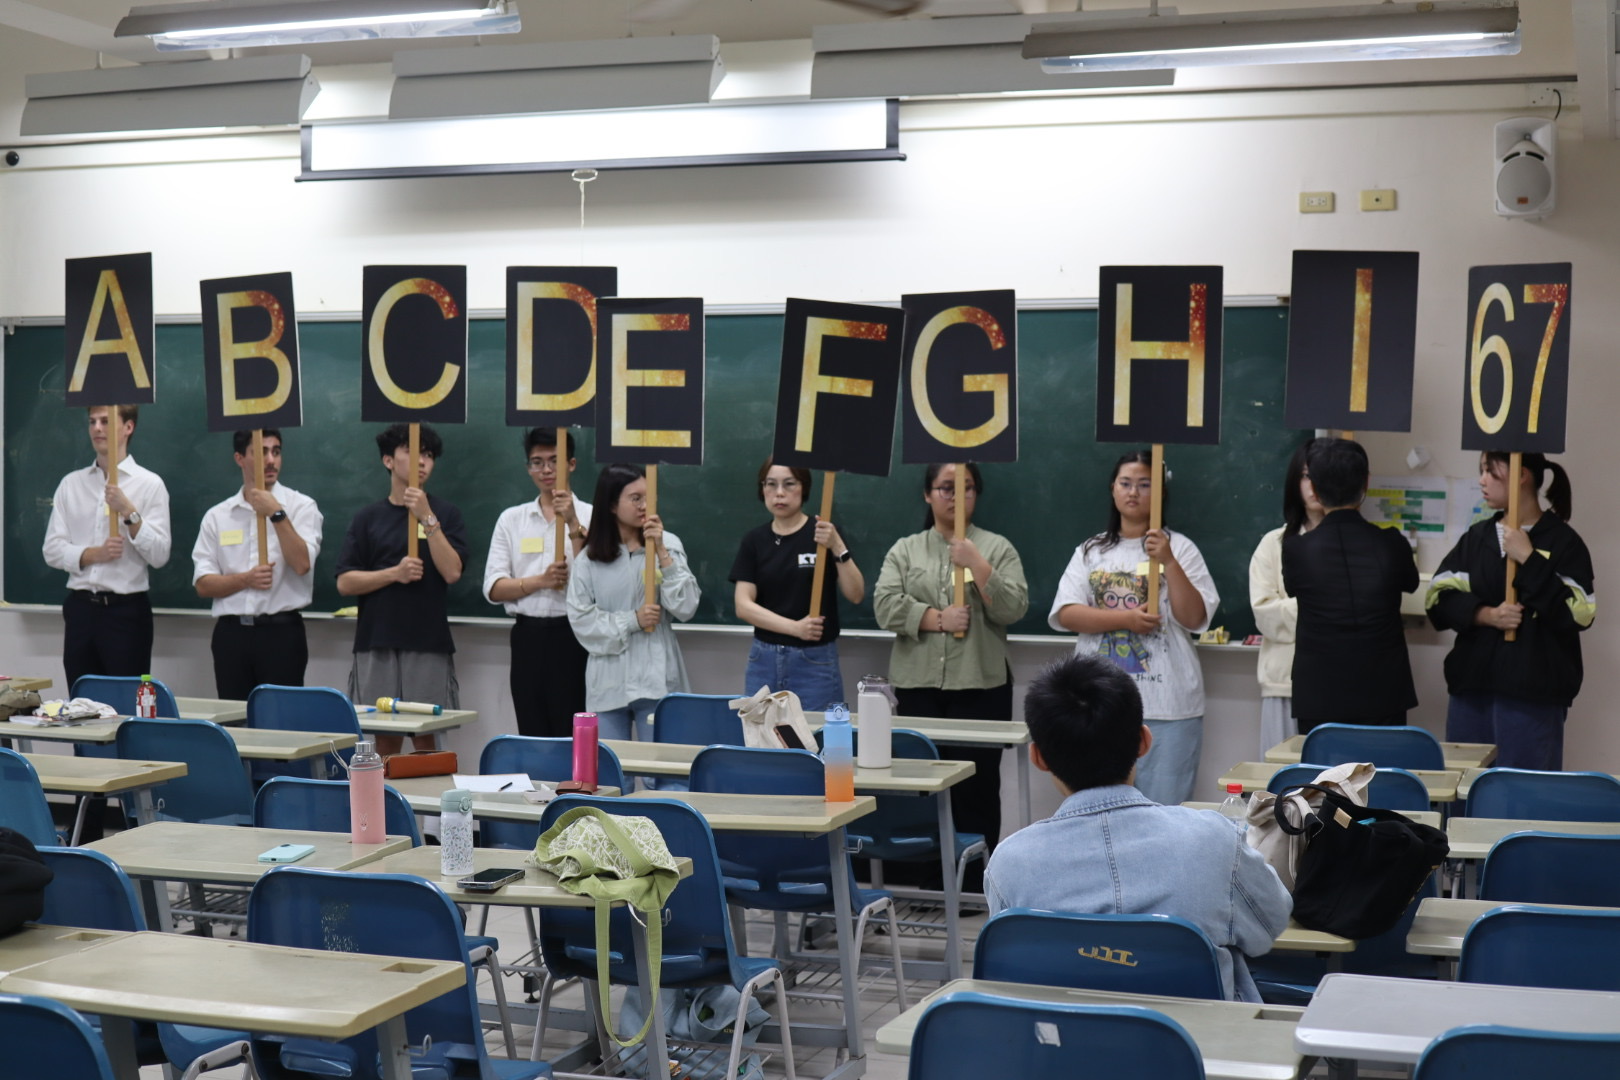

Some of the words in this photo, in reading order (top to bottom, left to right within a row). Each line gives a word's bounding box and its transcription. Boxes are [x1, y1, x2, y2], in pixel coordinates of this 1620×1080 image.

[69, 271, 148, 392] A
[217, 291, 292, 416] B
[369, 278, 460, 408] C
[517, 282, 597, 410] D
[611, 314, 691, 447] E
[795, 317, 887, 452] F
[911, 306, 1008, 447] G
[1114, 284, 1206, 426] H
[1350, 269, 1372, 412] I
[1471, 283, 1568, 434] 67
